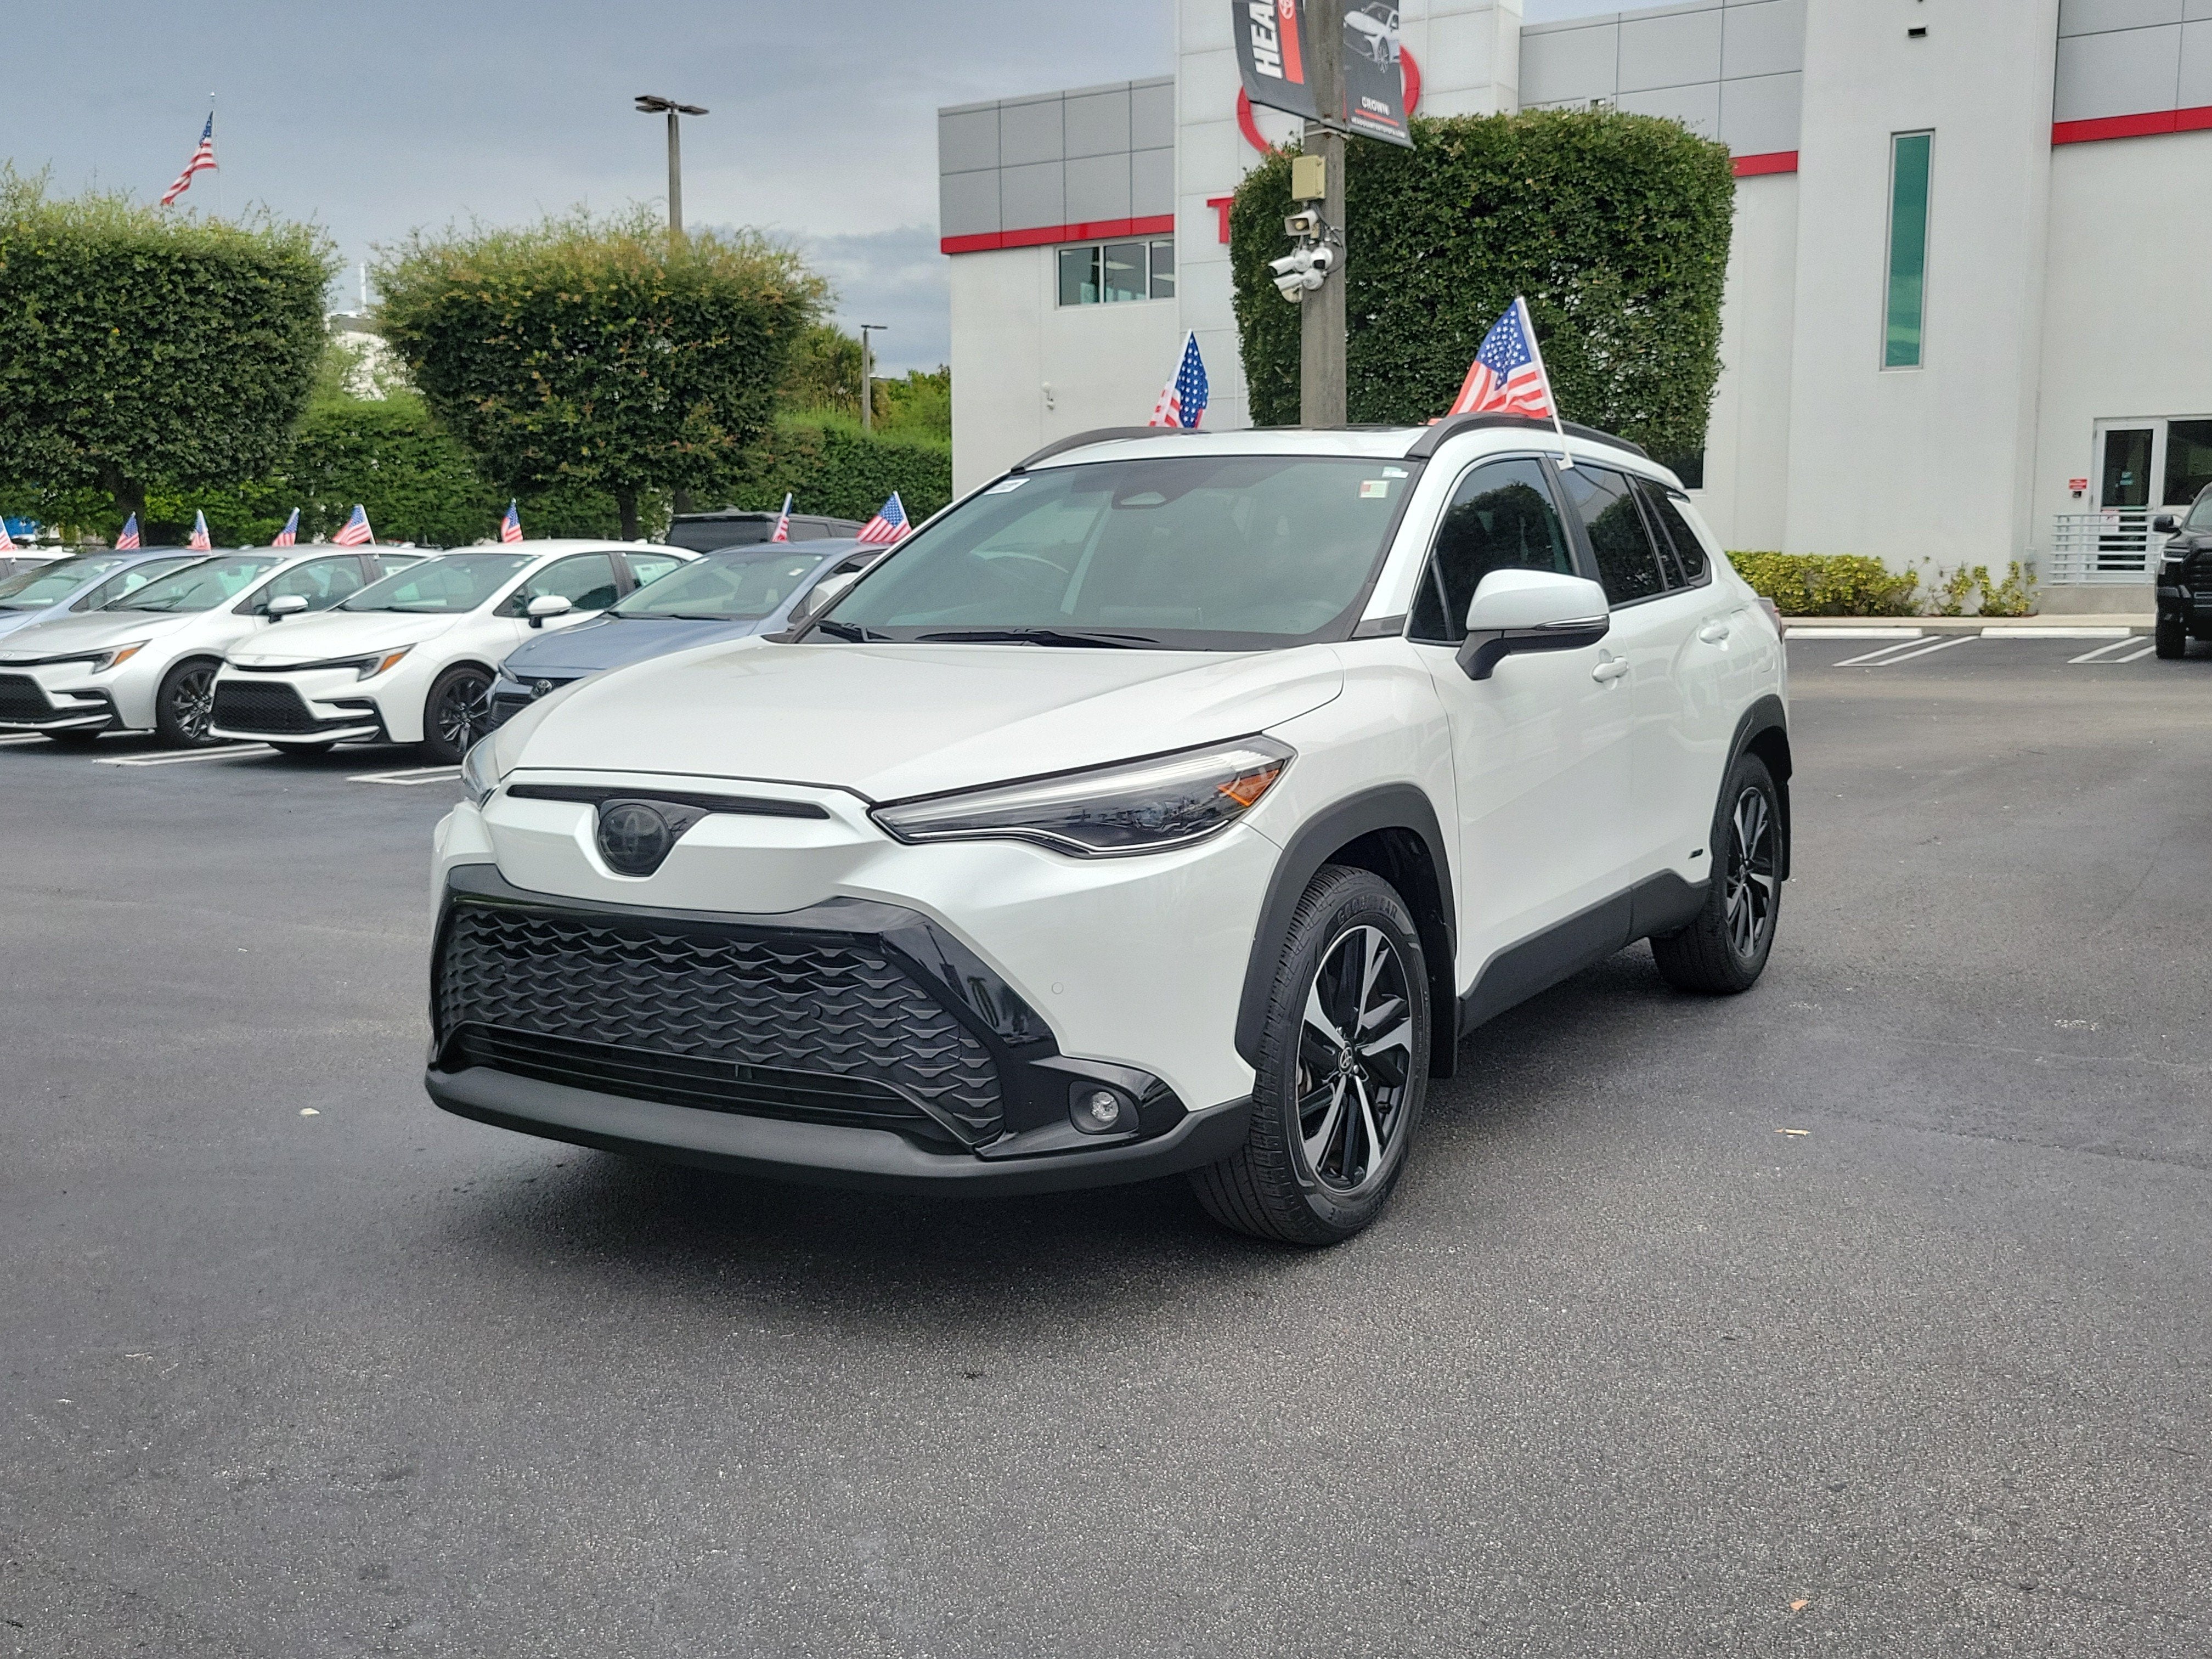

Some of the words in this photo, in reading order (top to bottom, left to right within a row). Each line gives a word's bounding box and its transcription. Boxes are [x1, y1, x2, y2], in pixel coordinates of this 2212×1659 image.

[1249, 0, 1283, 78] HEA
[1361, 96, 1391, 116] CROWN
[1338, 895, 1398, 926] GOOEAR
